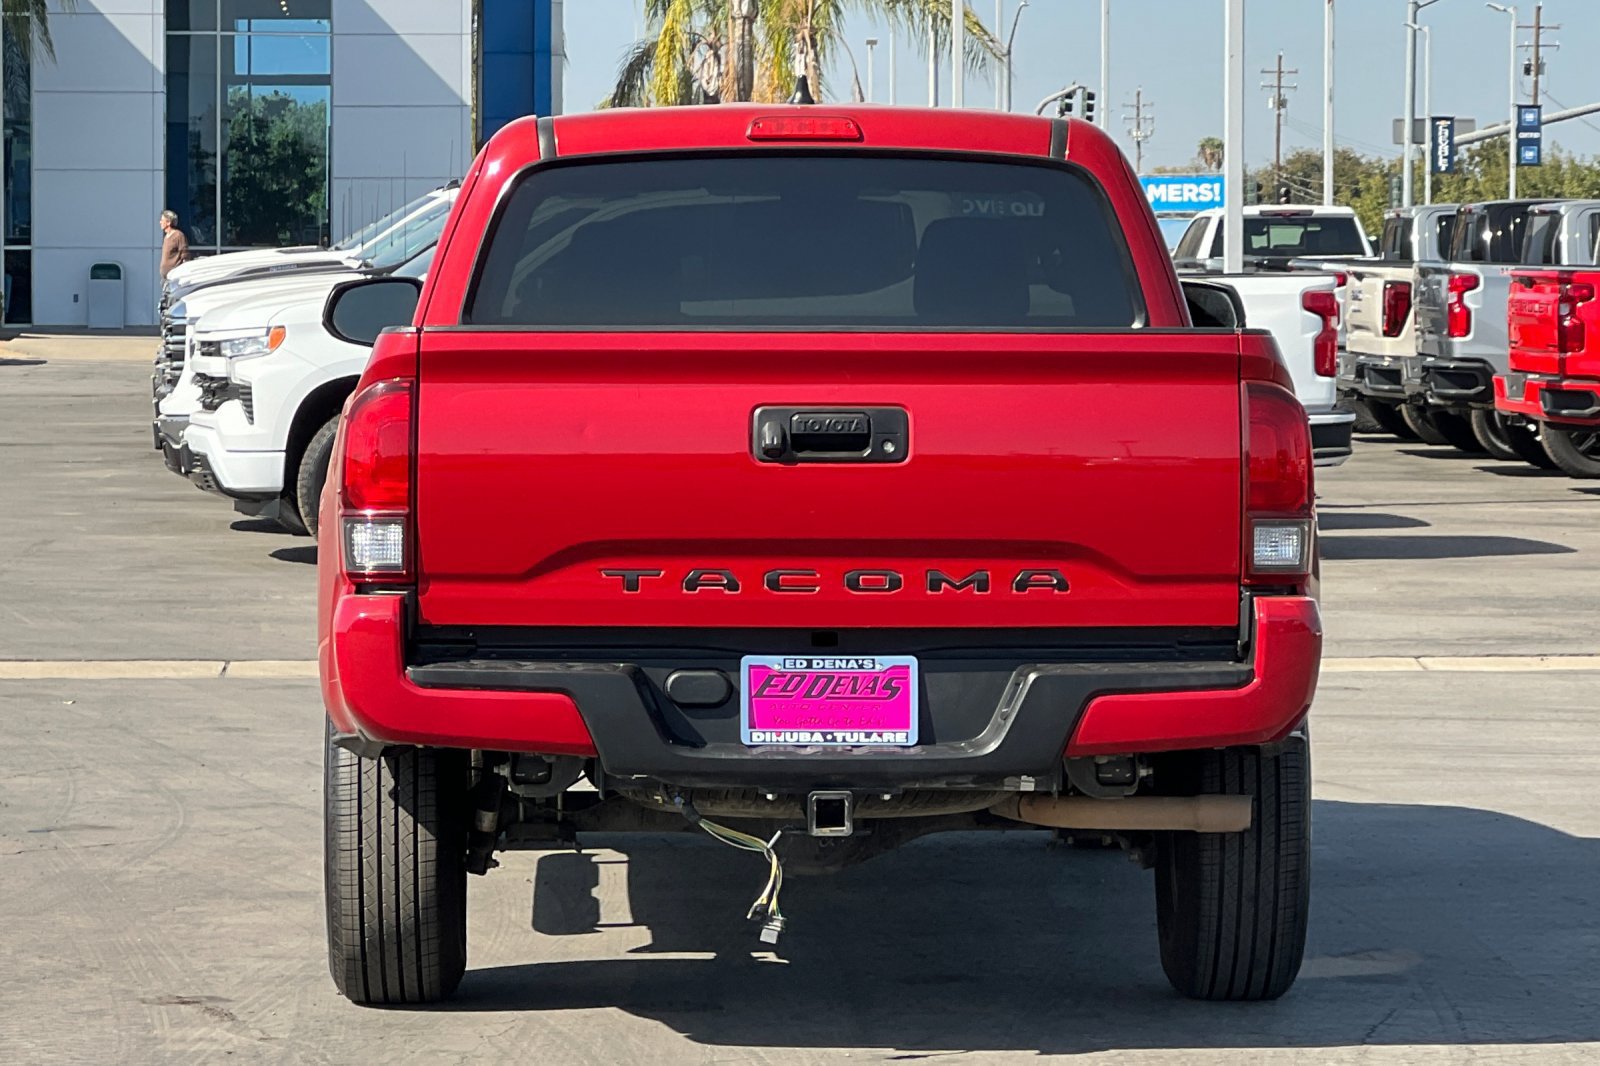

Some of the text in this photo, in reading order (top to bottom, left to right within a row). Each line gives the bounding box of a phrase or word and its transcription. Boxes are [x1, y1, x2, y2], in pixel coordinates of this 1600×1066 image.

[798, 418, 865, 432] TOYOTA
[599, 569, 1070, 593] TACOMA
[785, 659, 874, 669] ED DENA'S
[752, 674, 808, 699] ED
